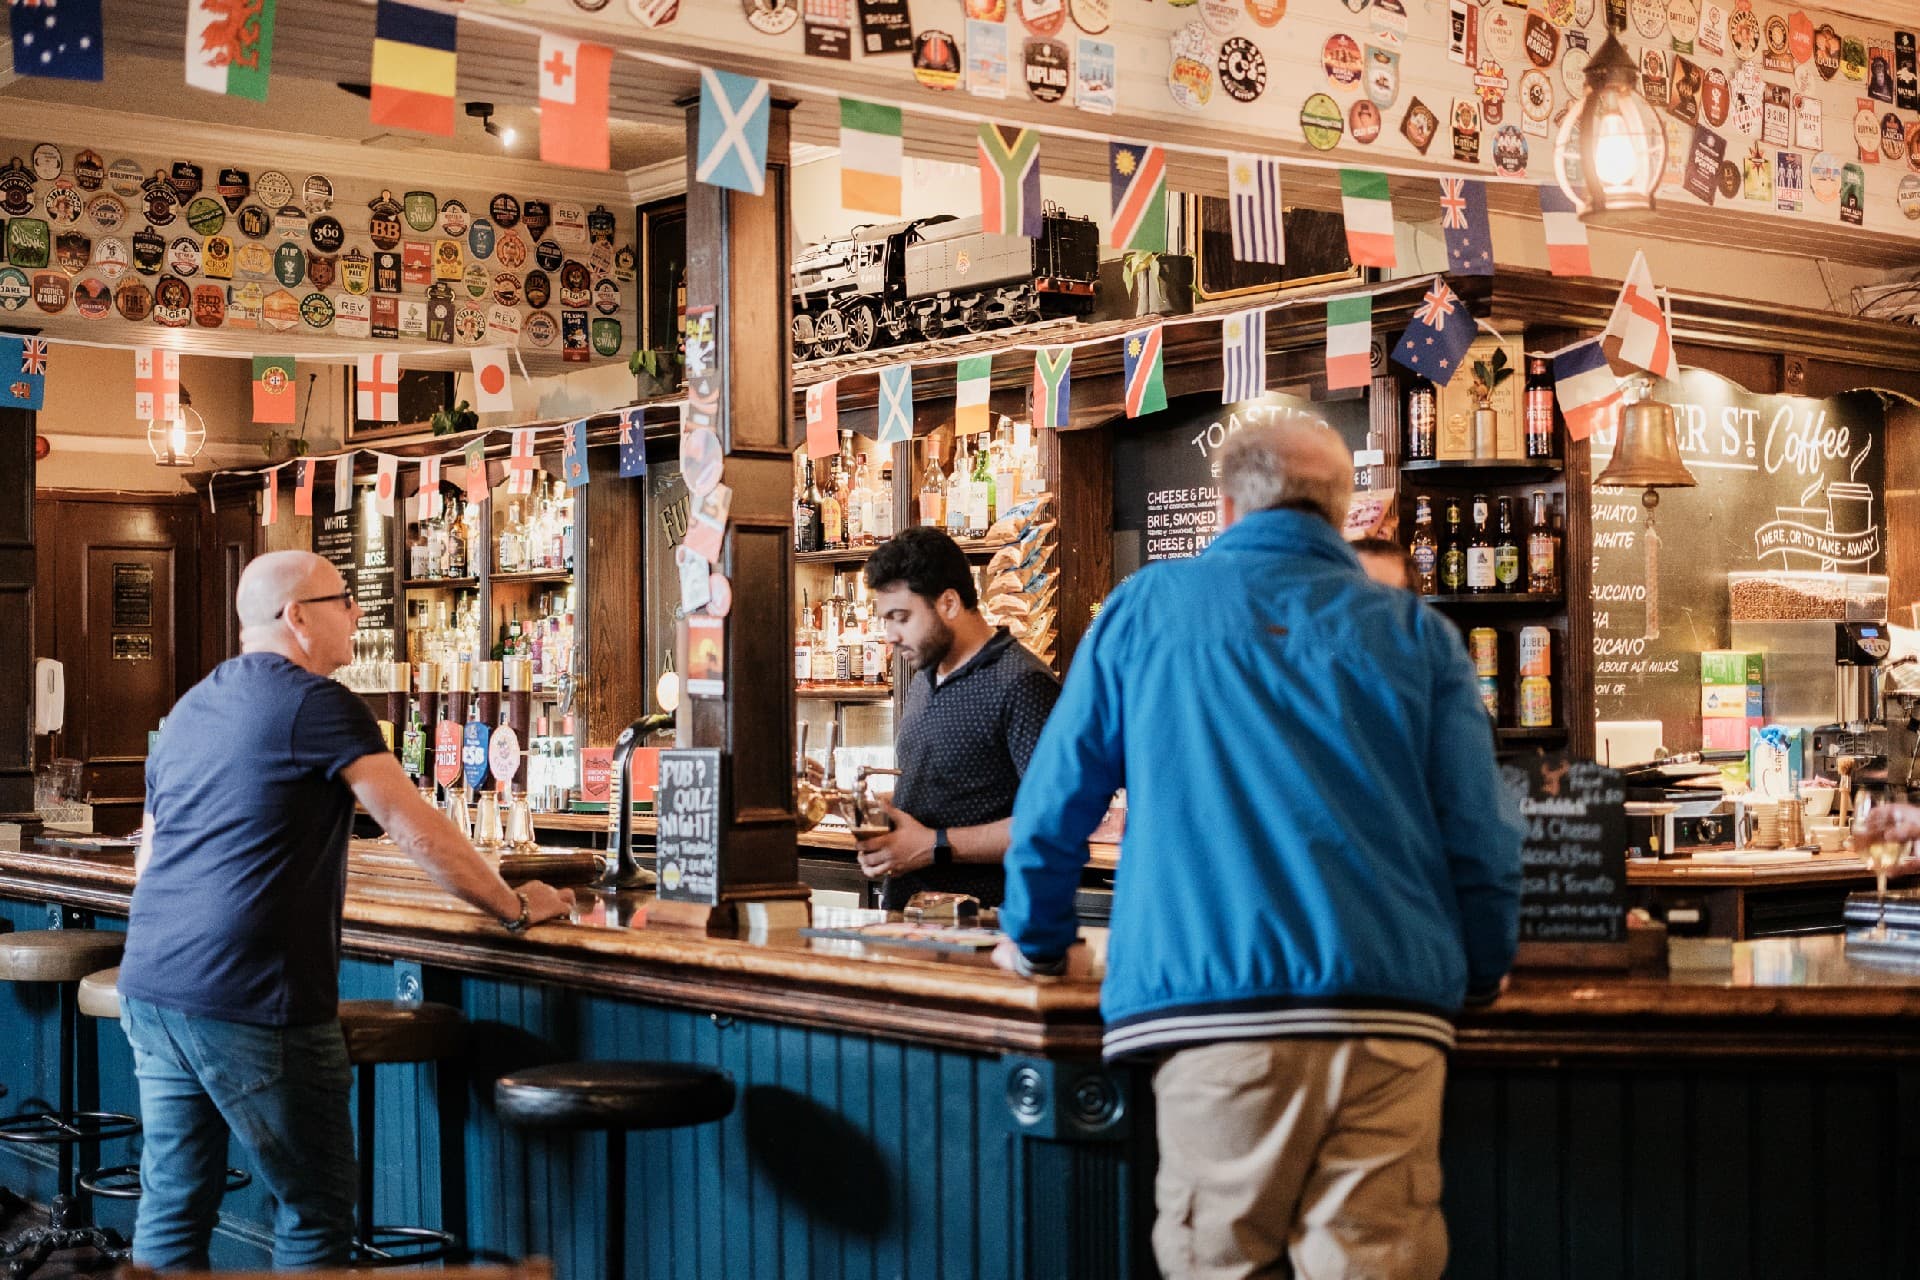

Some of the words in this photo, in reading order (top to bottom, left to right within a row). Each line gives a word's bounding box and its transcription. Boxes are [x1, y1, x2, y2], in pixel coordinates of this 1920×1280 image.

[341, 301, 364, 311] REV
[1763, 404, 1851, 475] Coffee
[1147, 489, 1189, 504] CHEESE
[1189, 488, 1197, 502] &
[324, 515, 349, 530] WHITE
[1172, 509, 1215, 527] SMOKED
[1147, 537, 1186, 553] CHEESE
[1187, 537, 1193, 550] &
[1789, 529, 1801, 545] OR
[1803, 532, 1815, 547] TO
[1596, 661, 1627, 672] ABOUT
[1647, 659, 1679, 673] MILKS
[435, 752, 457, 766] PRIDE
[662, 760, 694, 789] PUB
[673, 787, 712, 812] QUIZ
[660, 812, 712, 839] NIGHT
